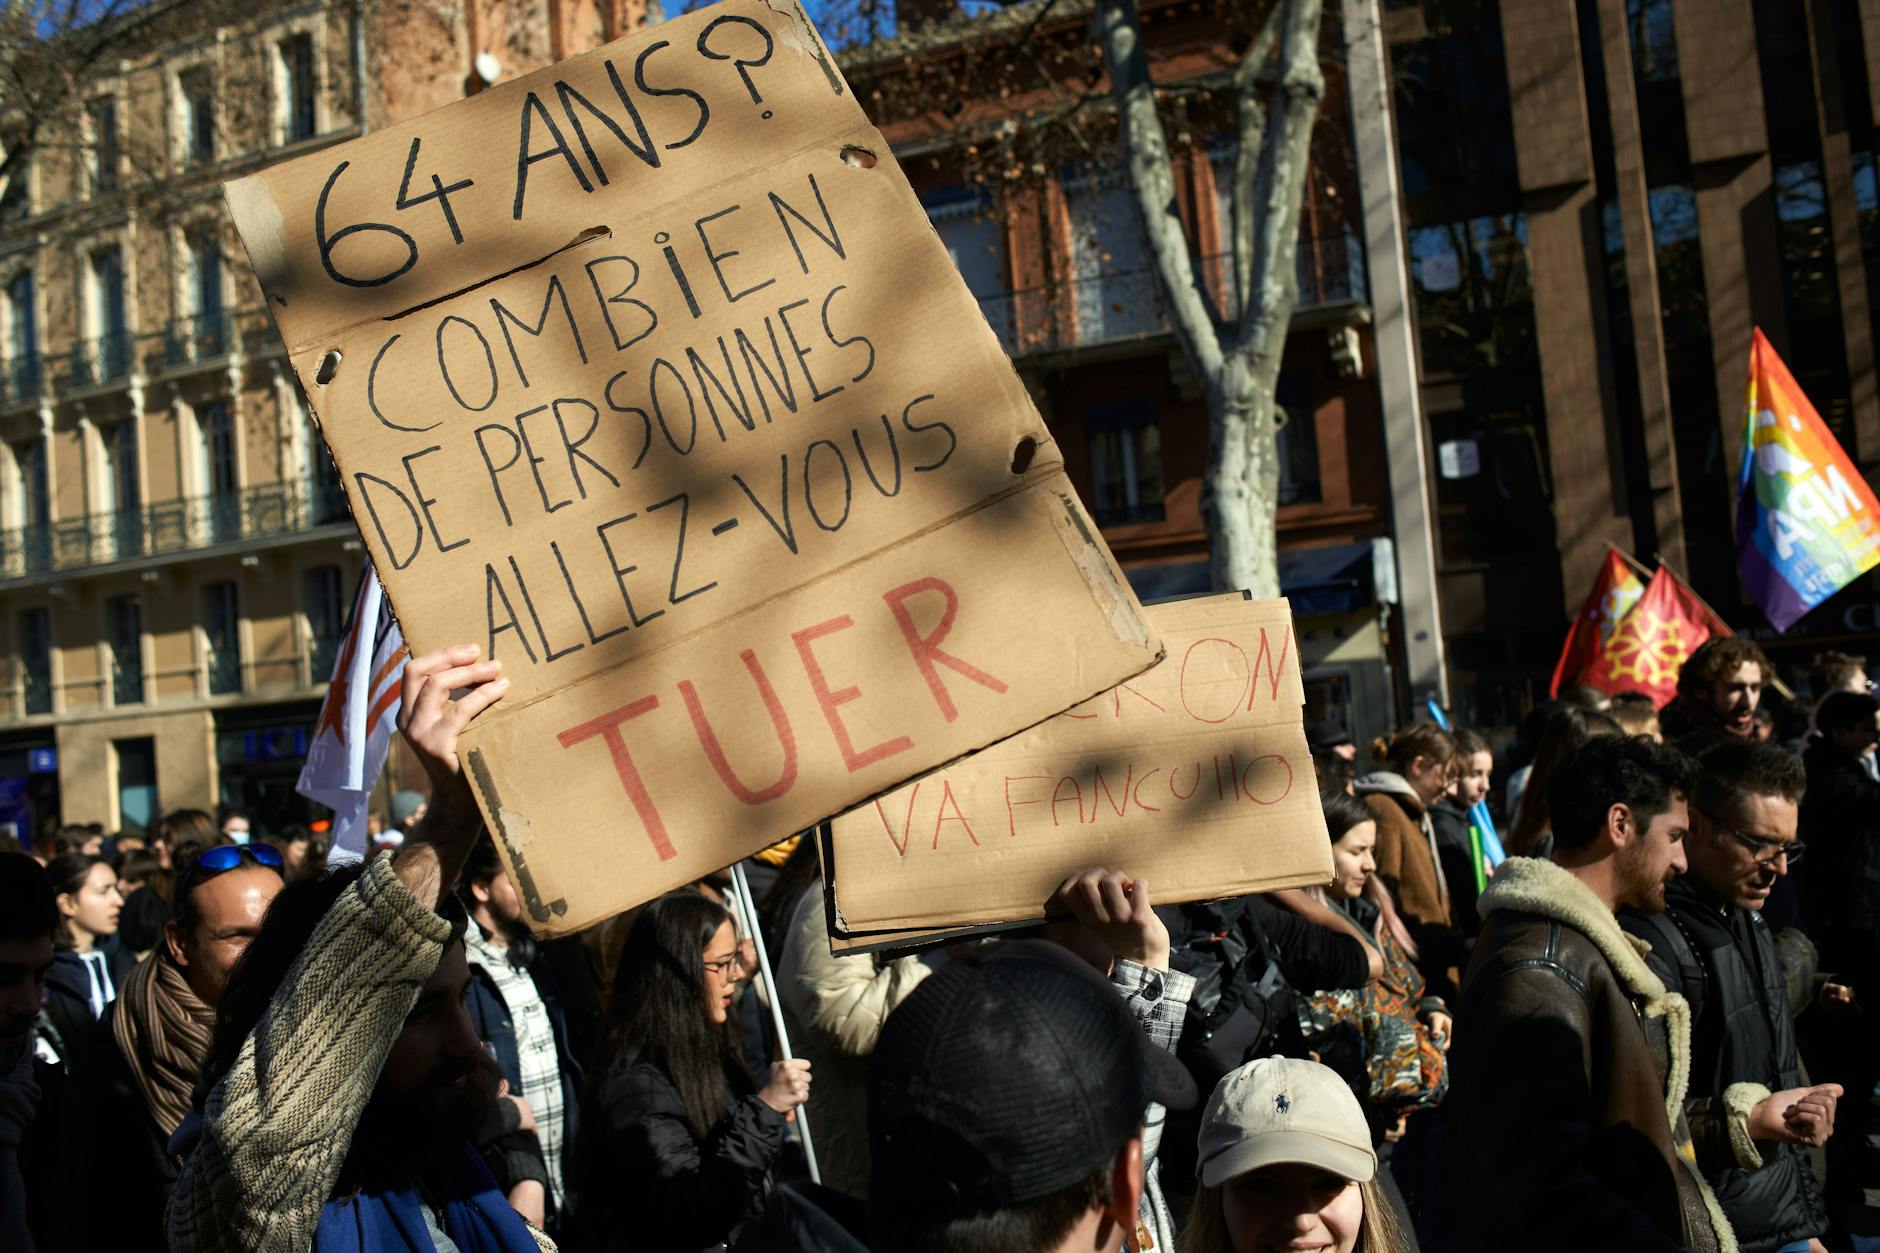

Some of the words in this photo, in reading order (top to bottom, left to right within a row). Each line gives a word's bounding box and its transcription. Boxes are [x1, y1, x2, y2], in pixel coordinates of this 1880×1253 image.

[316, 137, 474, 288] 64
[513, 15, 774, 221] ANS?
[353, 445, 472, 571] DE
[475, 285, 876, 527] PERSONNES
[486, 394, 957, 665] ALLEZ-VOUS
[556, 576, 1010, 863] TUER
[875, 780, 980, 857] VA
